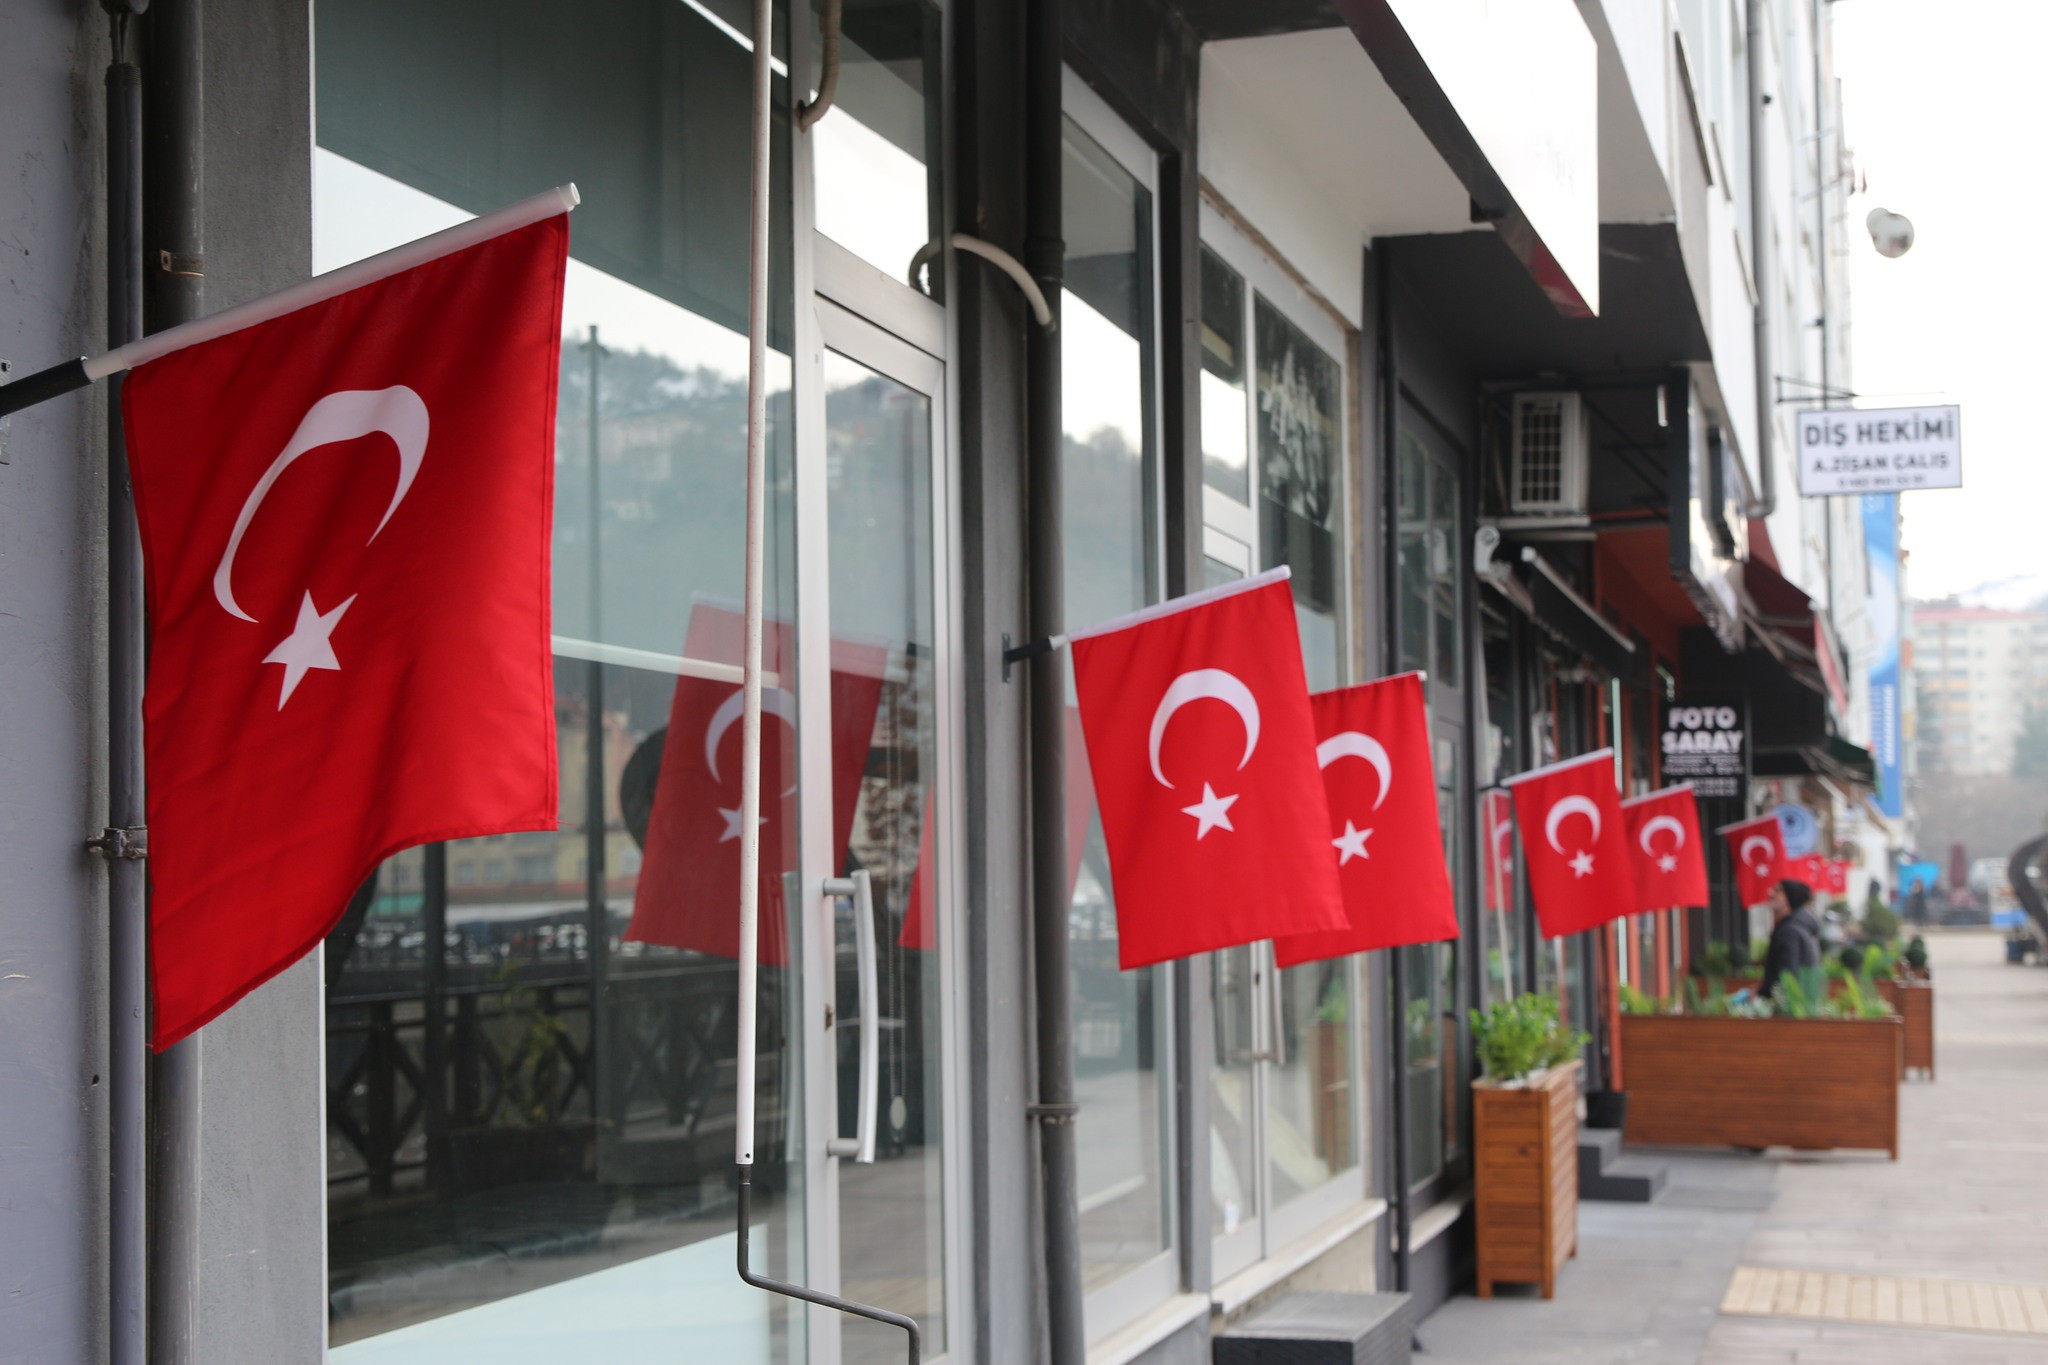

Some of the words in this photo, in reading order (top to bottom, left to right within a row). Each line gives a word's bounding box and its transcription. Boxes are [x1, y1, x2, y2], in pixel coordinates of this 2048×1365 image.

[1805, 417, 1847, 447] DİŞ
[1857, 411, 1954, 443] HEKİMİ
[1668, 706, 1736, 730] FOTO
[1661, 730, 1744, 754] SARAY
